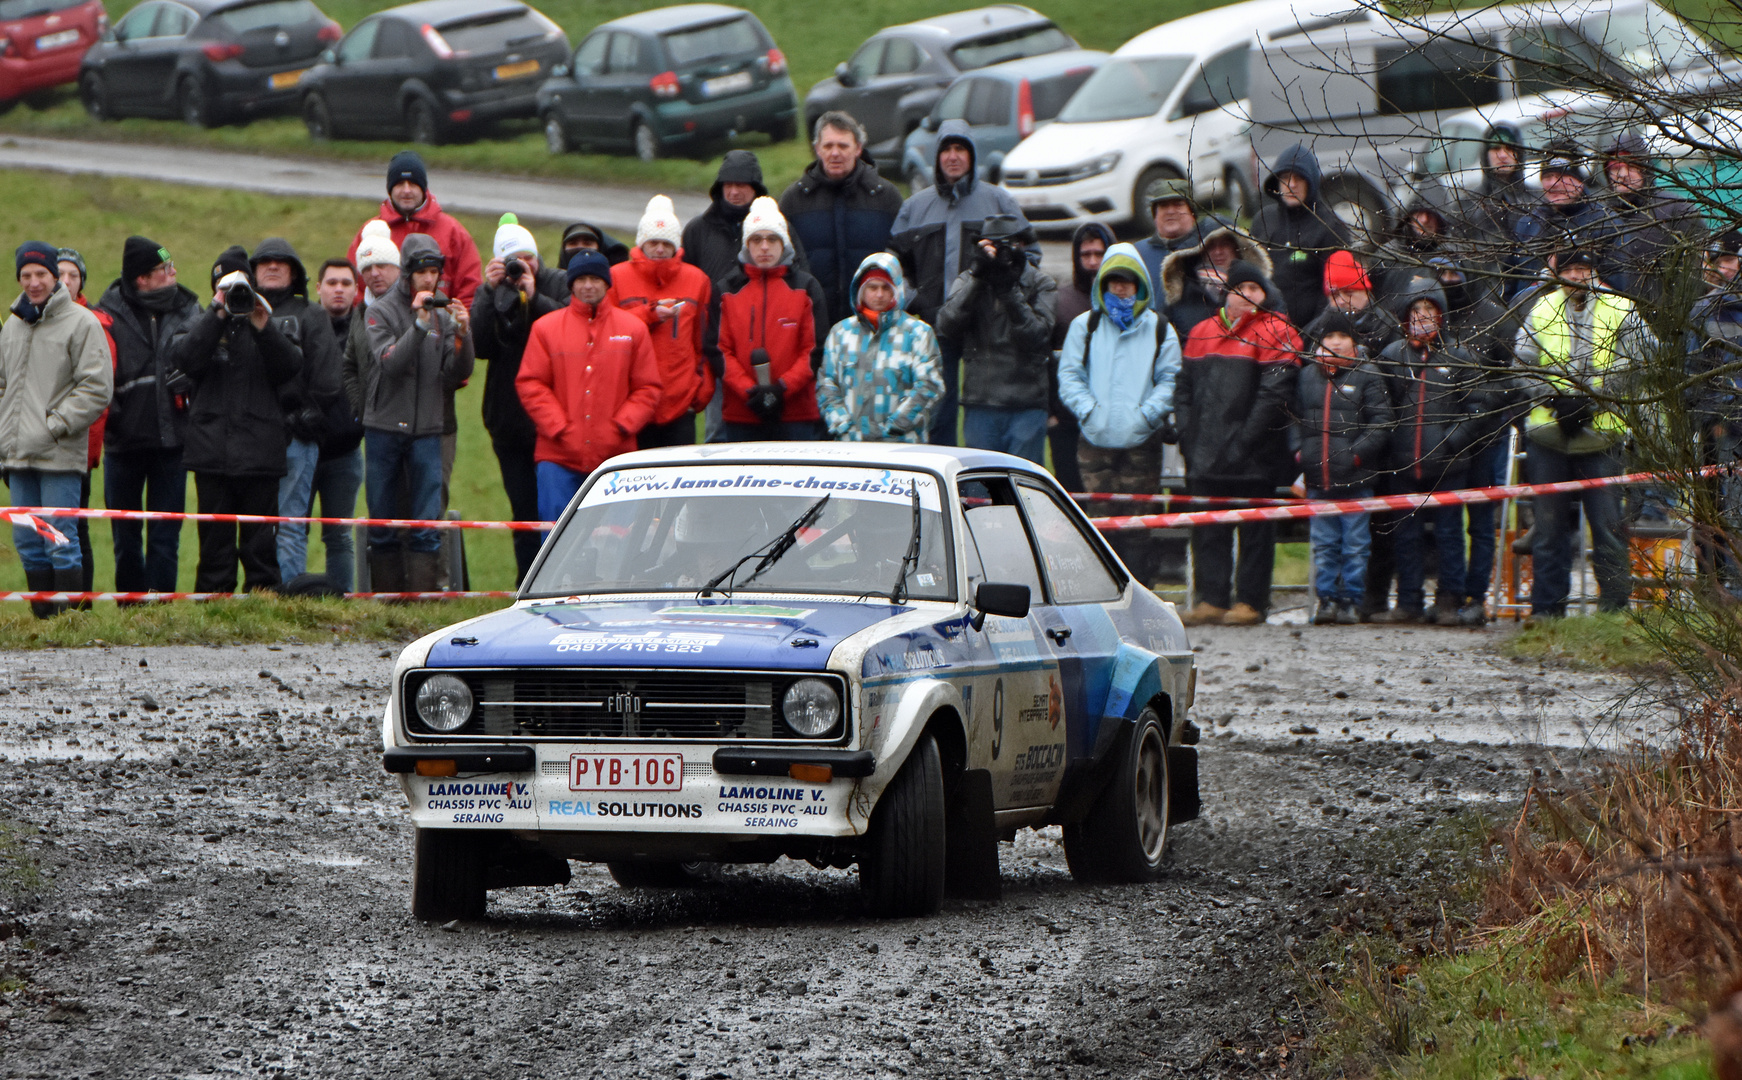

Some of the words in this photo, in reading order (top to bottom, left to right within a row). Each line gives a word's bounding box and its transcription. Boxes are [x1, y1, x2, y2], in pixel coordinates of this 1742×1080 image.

[603, 474, 915, 498] www.lamoline-chassis.be
[556, 643, 659, 653] 0497/413
[663, 644, 705, 653] 323
[607, 696, 641, 713] FORD
[991, 677, 1004, 761] 9
[427, 783, 509, 796] LAMOLINE
[515, 783, 530, 796] V.
[719, 785, 805, 801] LAMOLINE
[810, 788, 826, 802] V.
[427, 799, 475, 810] CHASSIS
[478, 799, 501, 810] PVC
[717, 802, 768, 814] CHASSIS
[771, 803, 796, 815] PVC
[452, 813, 504, 824] SERAING
[744, 816, 799, 828] SERAING
